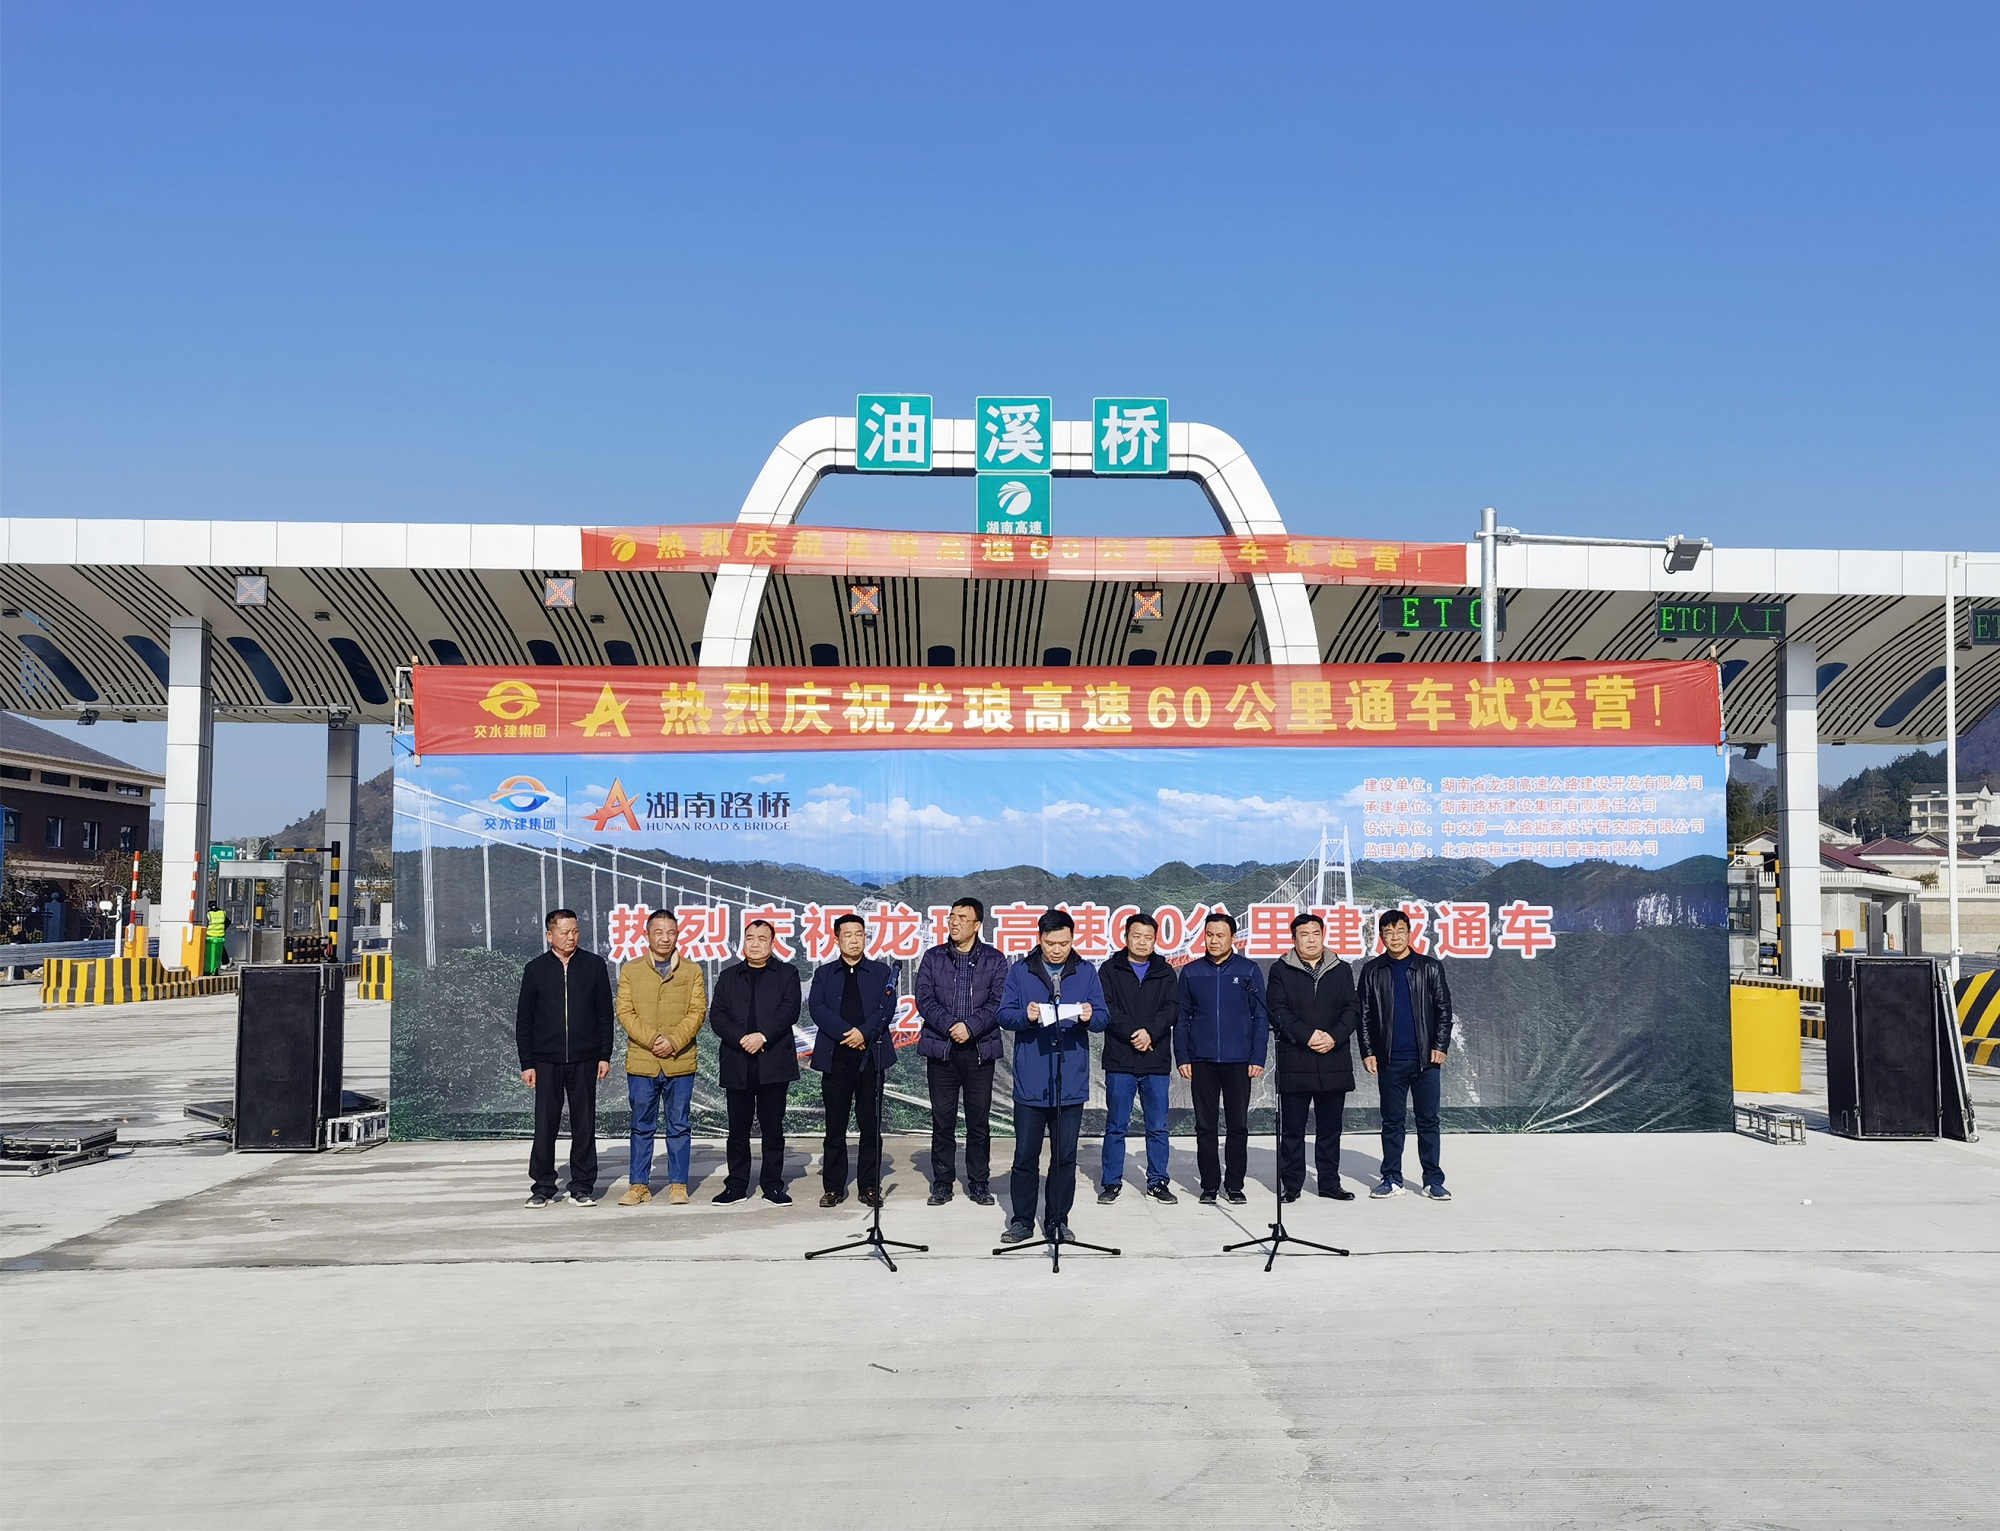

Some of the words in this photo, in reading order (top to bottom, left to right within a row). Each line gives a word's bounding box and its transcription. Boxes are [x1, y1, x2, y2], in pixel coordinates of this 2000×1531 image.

[864, 402, 1161, 465] 油溪桥
[986, 521, 1042, 534] 湖南高速
[474, 724, 547, 738] 交水建集团
[646, 791, 791, 819] 湖南路桥
[484, 817, 556, 831] 交水建集团
[646, 822, 690, 831] HUNAN
[694, 822, 729, 831] ROAD
[732, 822, 741, 831] &
[744, 822, 791, 831] BRIDGE
